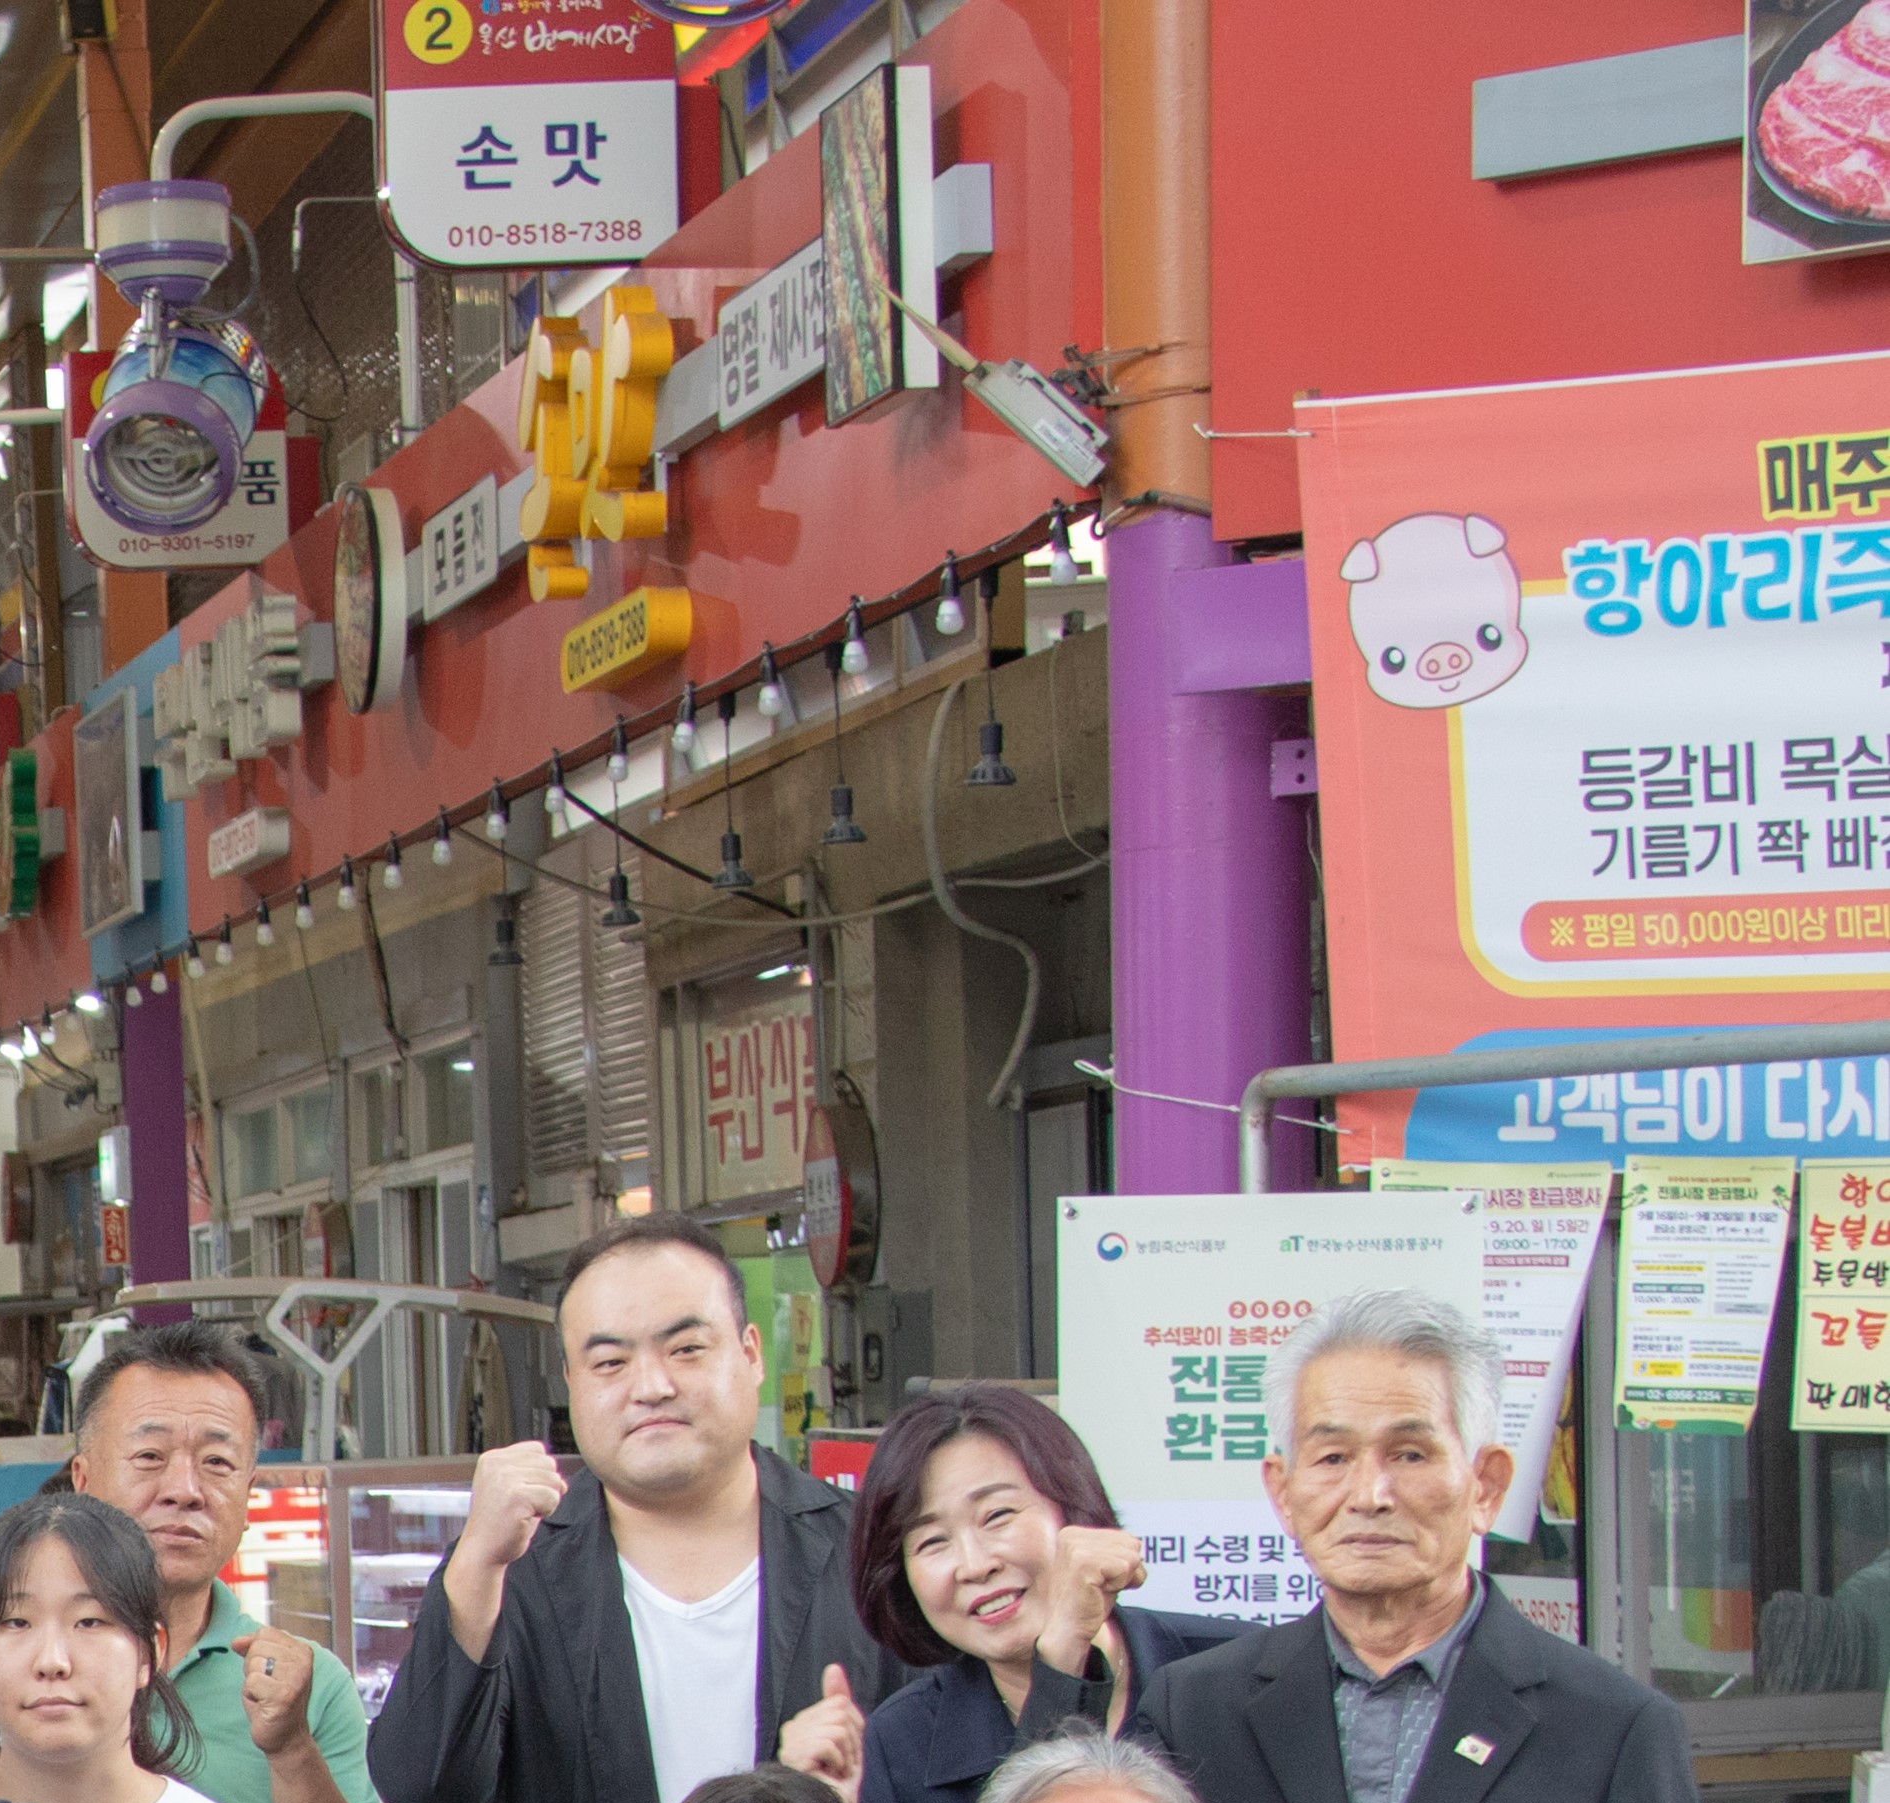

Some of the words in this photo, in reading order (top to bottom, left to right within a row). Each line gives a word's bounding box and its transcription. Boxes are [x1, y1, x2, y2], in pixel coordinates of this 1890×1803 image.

[425, 7, 453, 50] 2
[455, 121, 608, 190] 손맛
[448, 219, 643, 249] 010-8518-7388
[119, 534, 255, 554] 010-9301-5197
[1579, 741, 1757, 812] 등갈비
[1592, 820, 1741, 880] 기름기
[1826, 815, 1890, 872] 빠
[1582, 912, 1636, 948] 평일
[1643, 906, 1827, 946] 50,000원이상
[1488, 1187, 1523, 1208] 시장
[1527, 1186, 1601, 1207] 환급행사
[1135, 1239, 1226, 1254] 농림축산식품부
[1280, 1235, 1303, 1252] aT
[1307, 1236, 1443, 1253] 한국농수산식품유통공사
[1492, 1238, 1530, 1250] 09:00
[1543, 1238, 1577, 1250] 17:00
[1144, 1326, 1221, 1347] 추석맞이
[1229, 1324, 1300, 1346] 농축산
[1169, 1354, 1270, 1404] 전통
[1164, 1412, 1271, 1461] 환급
[1193, 1534, 1249, 1565] 수령
[1258, 1534, 1285, 1563] 및
[1193, 1573, 1280, 1602] 방지를
[1285, 1572, 1322, 1602] 위
